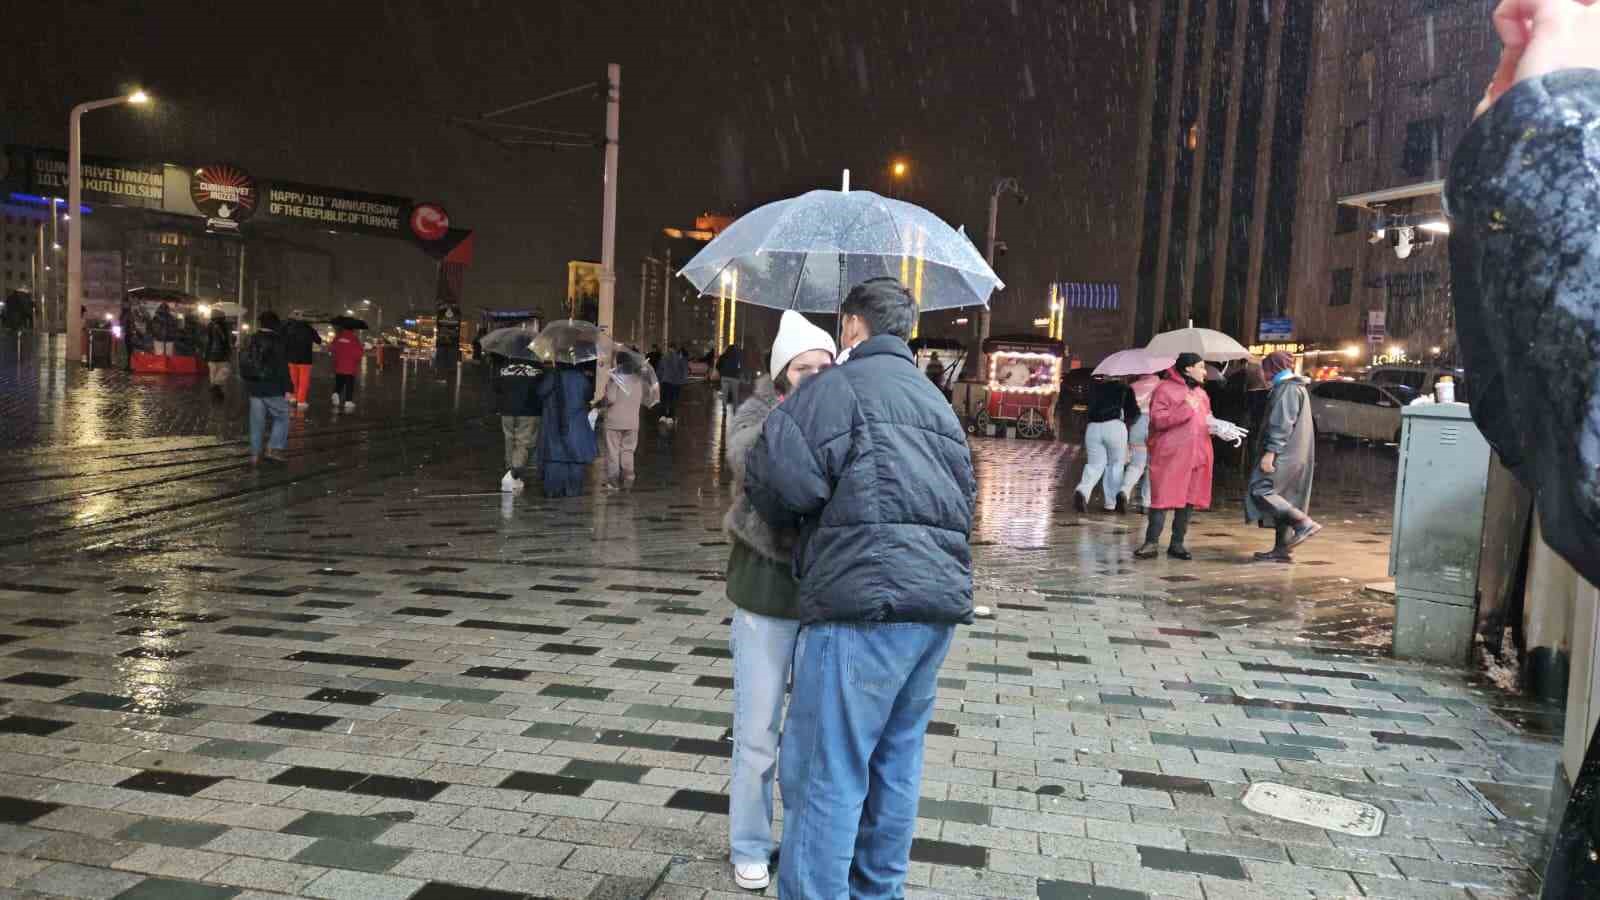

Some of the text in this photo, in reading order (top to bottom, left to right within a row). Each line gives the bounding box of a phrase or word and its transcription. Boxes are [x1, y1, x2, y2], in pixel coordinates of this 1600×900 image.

[86, 178, 121, 194] KUTLU
[124, 183, 163, 200] OLSUN
[270, 189, 304, 204] HAPPY
[270, 202, 283, 215] OF
[283, 203, 302, 217] THE
[303, 206, 347, 222] REPUBLIC
[348, 211, 361, 225] OF
